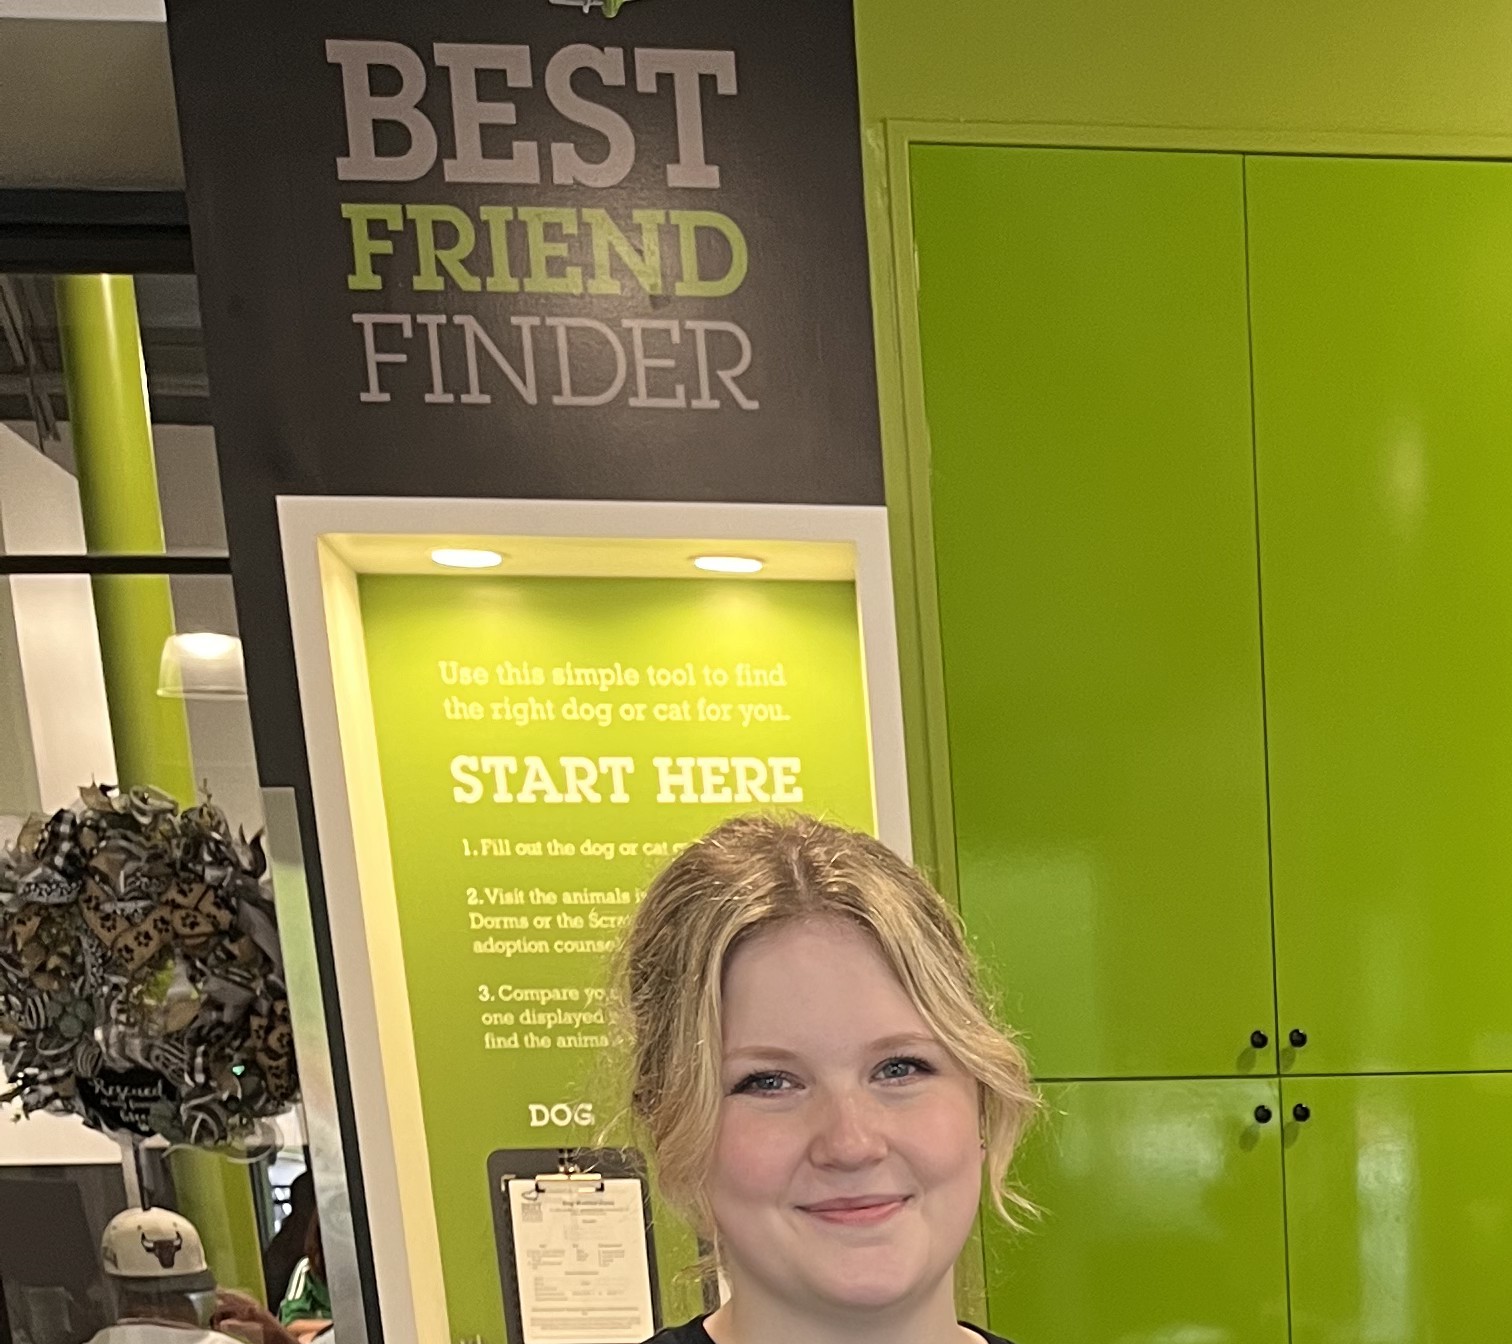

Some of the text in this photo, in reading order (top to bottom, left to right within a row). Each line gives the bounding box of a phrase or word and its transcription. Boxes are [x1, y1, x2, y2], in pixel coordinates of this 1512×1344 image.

[325, 39, 737, 188] BEST
[341, 203, 748, 297] FRIEND
[352, 313, 759, 410] FINDER
[438, 661, 787, 691] Use this simple tool to find
[443, 697, 790, 727] the right dog or cat for you.
[450, 755, 804, 803] START HERE
[463, 839, 478, 856] 1.
[481, 839, 510, 856] Fill
[515, 840, 544, 856] out
[547, 839, 576, 856] the
[580, 839, 615, 860] dog
[619, 842, 639, 856] or
[642, 841, 668, 856] cat
[466, 888, 484, 905] 2.
[485, 887, 525, 905] Visit
[529, 888, 557, 904] the
[562, 888, 630, 904] animals
[468, 912, 530, 929] Dorms
[533, 916, 552, 929] or
[557, 913, 584, 929] the
[473, 936, 549, 957] adoption
[478, 985, 495, 1001] 3.
[498, 985, 580, 1005] Compare
[481, 1008, 604, 1029] one displayed
[484, 1032, 520, 1049] find
[524, 1032, 551, 1048] the
[528, 1103, 595, 1127] DOG
